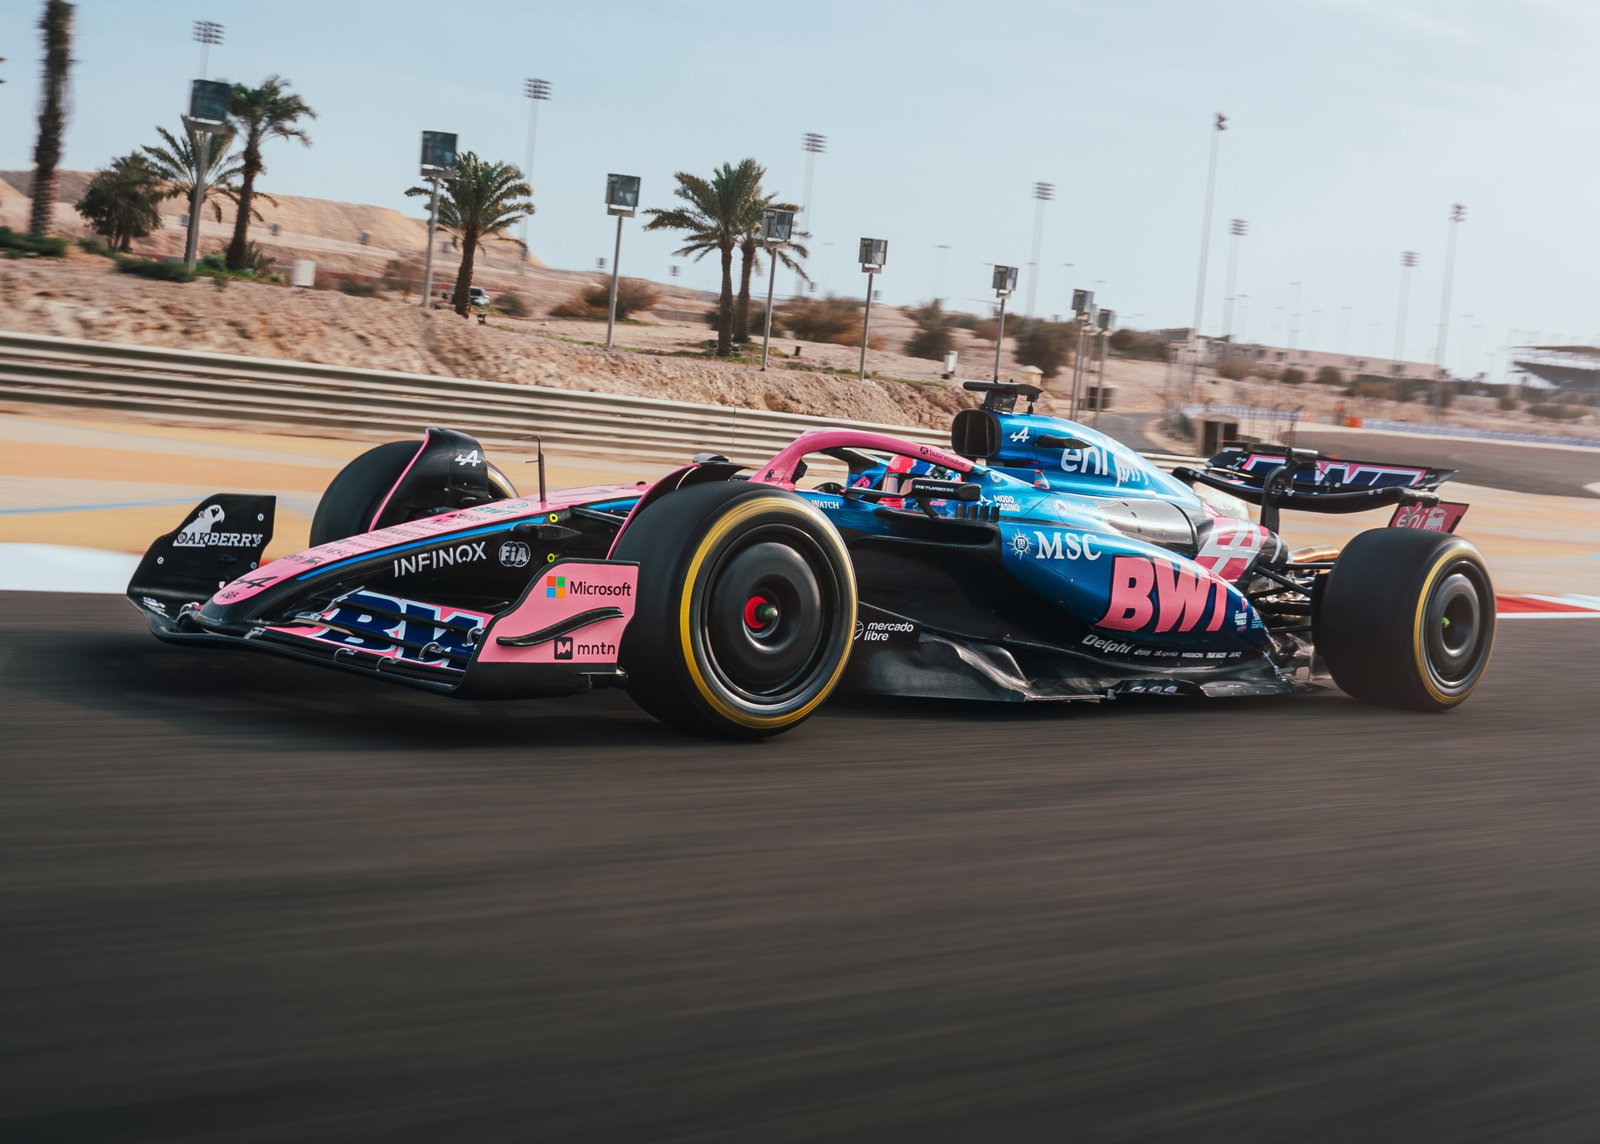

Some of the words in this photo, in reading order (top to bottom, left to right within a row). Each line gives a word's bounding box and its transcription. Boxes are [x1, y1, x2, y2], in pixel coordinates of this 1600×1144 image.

[173, 532, 262, 547] OAKBERRY
[1033, 531, 1101, 560] MSC
[394, 542, 487, 577] INFINOX
[569, 581, 632, 596] Microsoft
[867, 622, 914, 632] mercado
[864, 631, 889, 641] libre
[1082, 634, 1134, 653] Delphi
[577, 642, 616, 655] mntn
